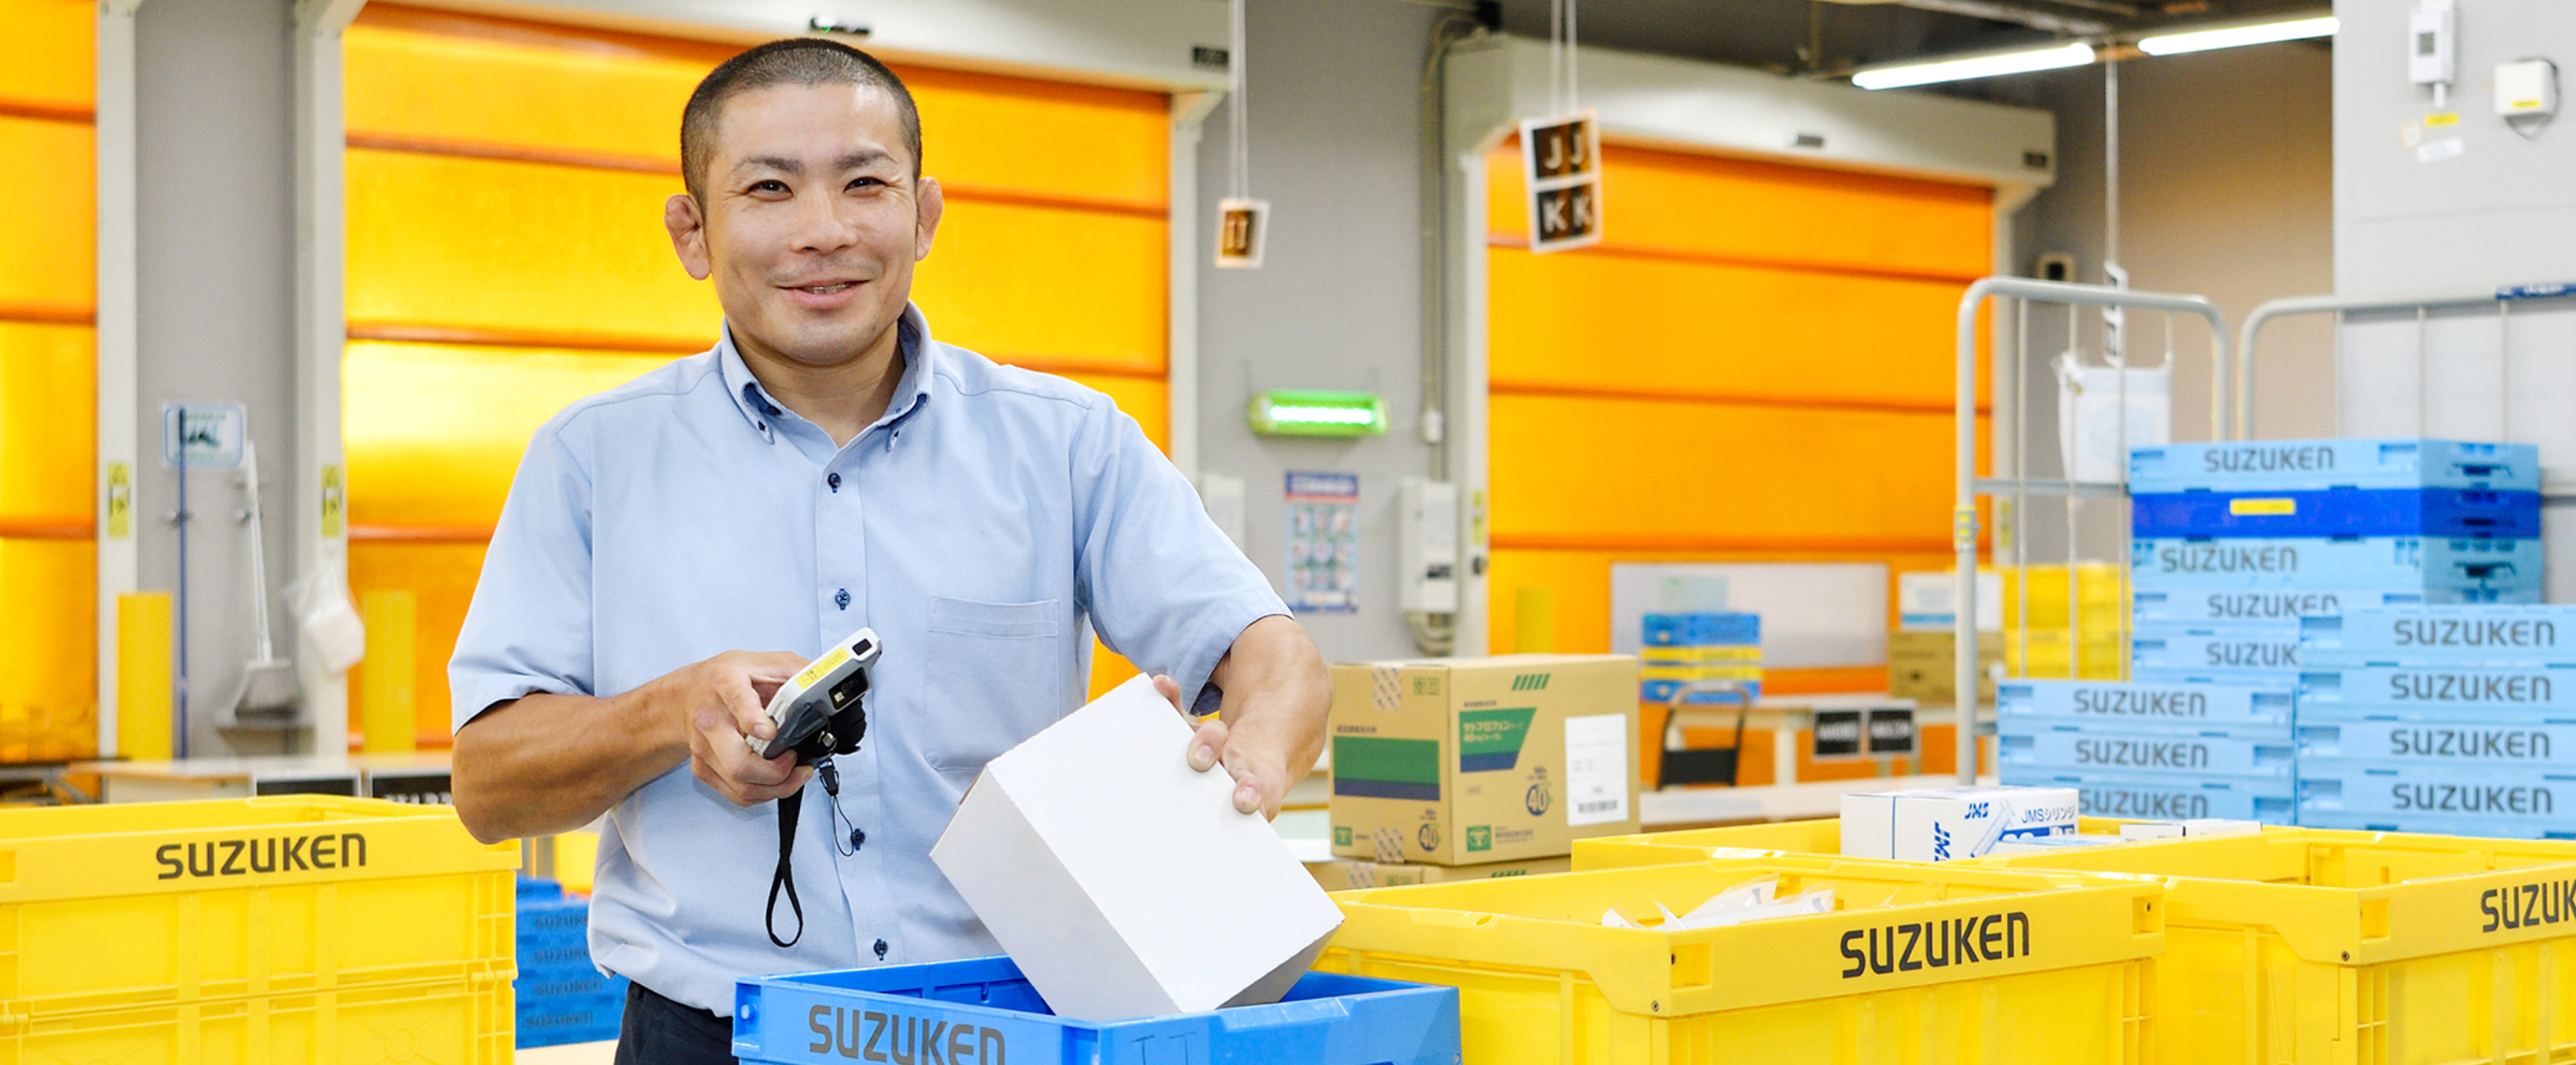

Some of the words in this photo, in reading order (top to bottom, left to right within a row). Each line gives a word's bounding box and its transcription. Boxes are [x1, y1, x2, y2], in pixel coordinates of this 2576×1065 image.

[1543, 195, 1594, 233] KK
[2205, 446, 2334, 473] SUZUKEN
[2160, 546, 2297, 573] SUZUKEN
[2394, 619, 2555, 646] SUZUKEN
[2074, 688, 2206, 716] SUZUKEN
[2391, 673, 2551, 703] SUZUKEN
[2075, 738, 2208, 768] SUZUKEN
[2390, 729, 2550, 759] SUZUKEN
[1964, 802, 1989, 819] JMS
[2079, 789, 2208, 819] SUZUKEN
[2393, 783, 2552, 814] SUZUKEN
[2021, 806, 2075, 824] JMSシリンジ
[156, 833, 366, 880] SUZUKEN
[1841, 911, 2029, 979] SUZUKEN
[809, 1004, 1006, 1065] SUZUKEN
